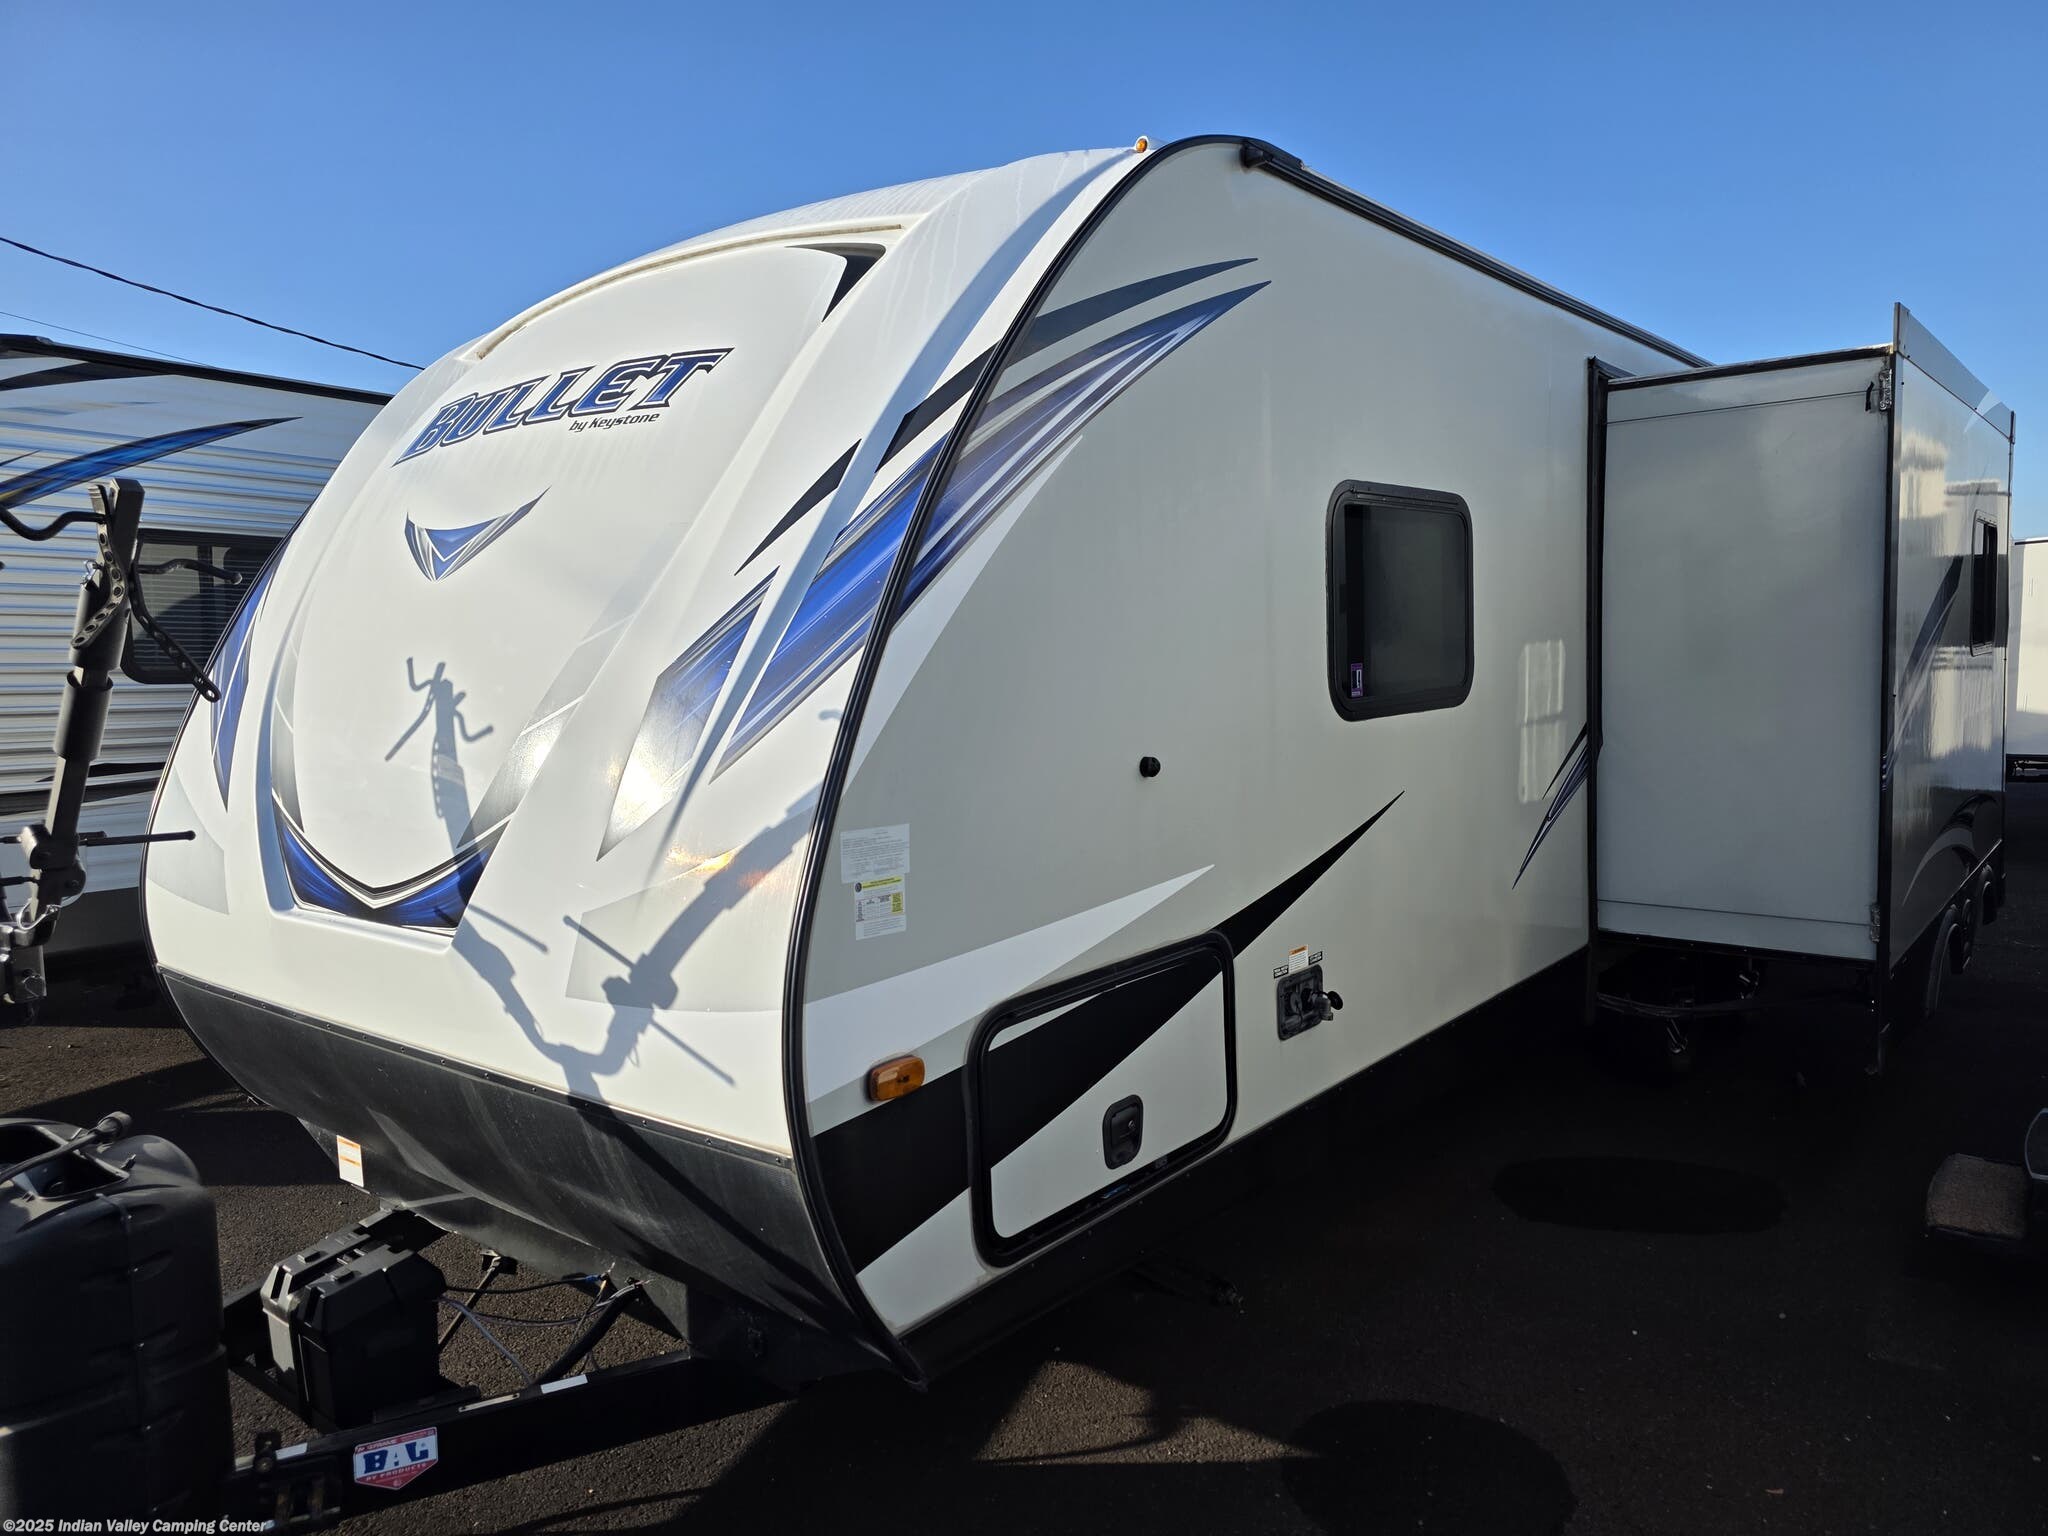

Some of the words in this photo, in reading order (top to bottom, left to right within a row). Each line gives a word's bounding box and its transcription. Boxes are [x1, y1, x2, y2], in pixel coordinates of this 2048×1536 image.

[391, 347, 735, 467] BULLET
[569, 419, 590, 433] by
[589, 412, 660, 430] Keystone
[363, 1441, 430, 1474] BAL
